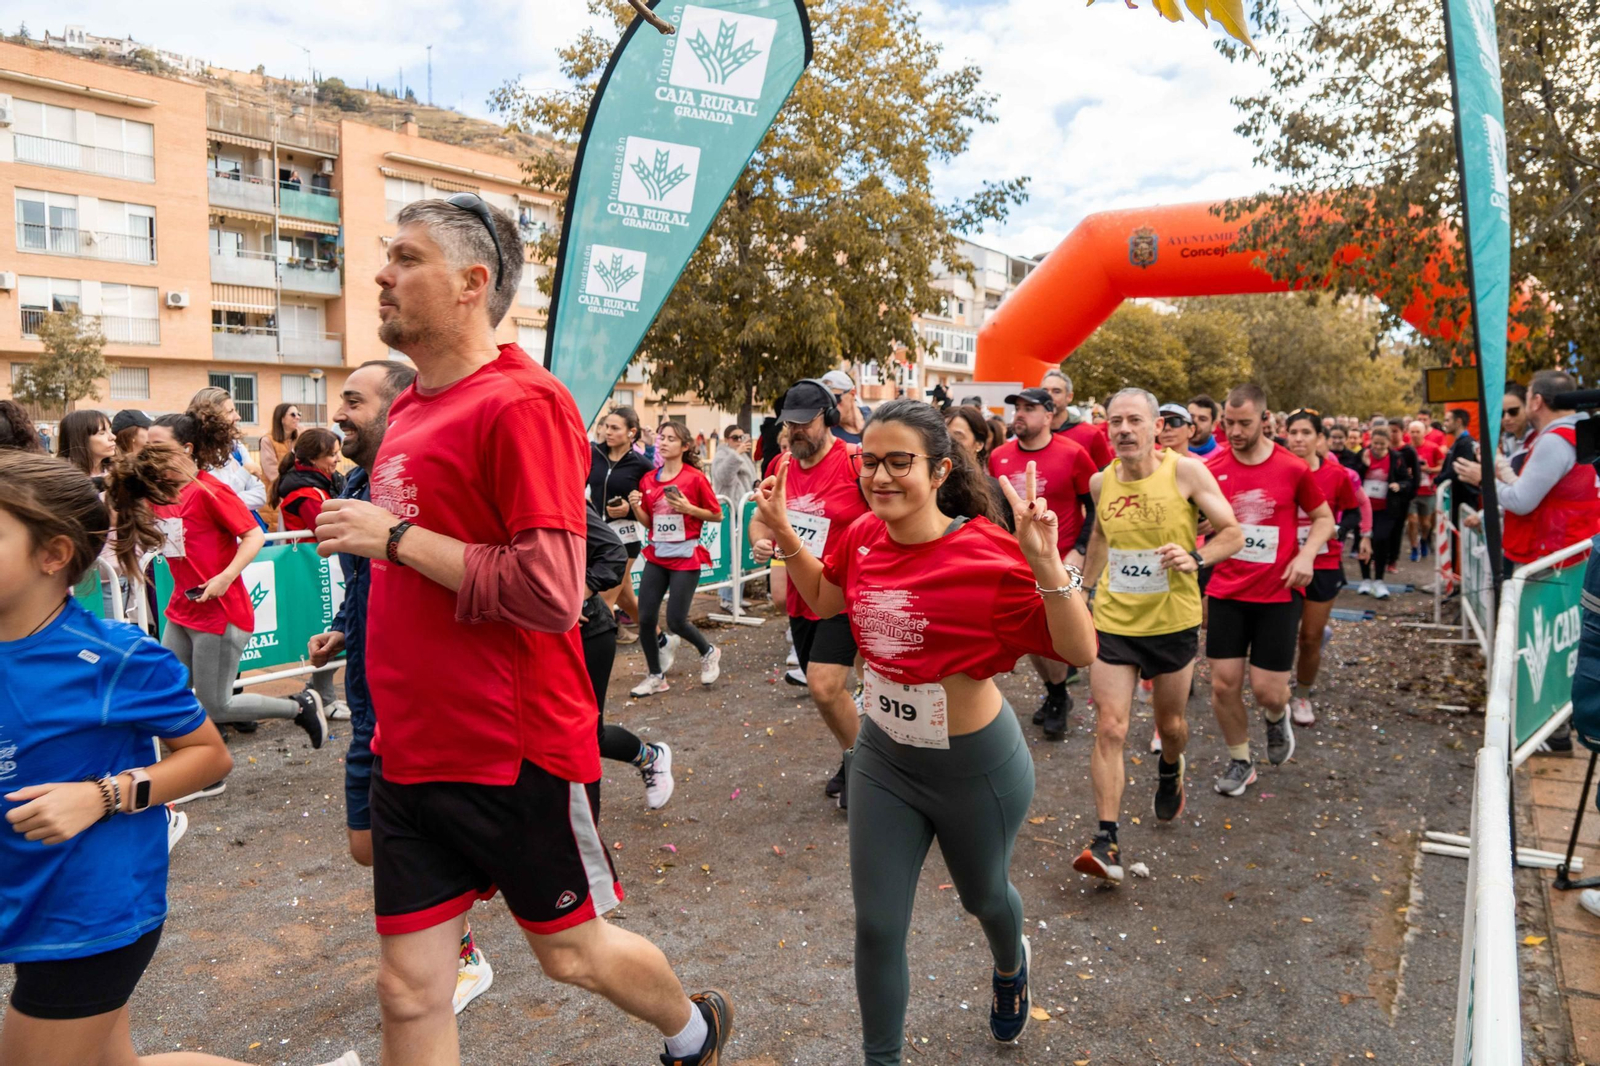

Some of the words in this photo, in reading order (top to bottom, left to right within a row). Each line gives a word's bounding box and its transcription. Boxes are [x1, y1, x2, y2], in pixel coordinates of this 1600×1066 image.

[657, 5, 683, 83] fundaión
[655, 86, 696, 106] CAJA
[699, 93, 758, 117] RURAL
[674, 105, 734, 125] GRANADA
[607, 136, 626, 201] fundación
[607, 202, 640, 218] CAJA
[643, 208, 690, 227] RURAL
[622, 217, 670, 233] GRANADA
[1167, 232, 1234, 246] AYUNTAMIE
[578, 245, 592, 294] fundación
[578, 294, 601, 305] CAJA
[603, 298, 640, 312] RURAL
[587, 305, 625, 317] GRANADA
[619, 524, 636, 535] 615
[657, 523, 677, 532] 200
[1245, 537, 1267, 550] 94
[1121, 565, 1152, 577] 424
[318, 557, 332, 624] fundación
[879, 694, 918, 722] 919
